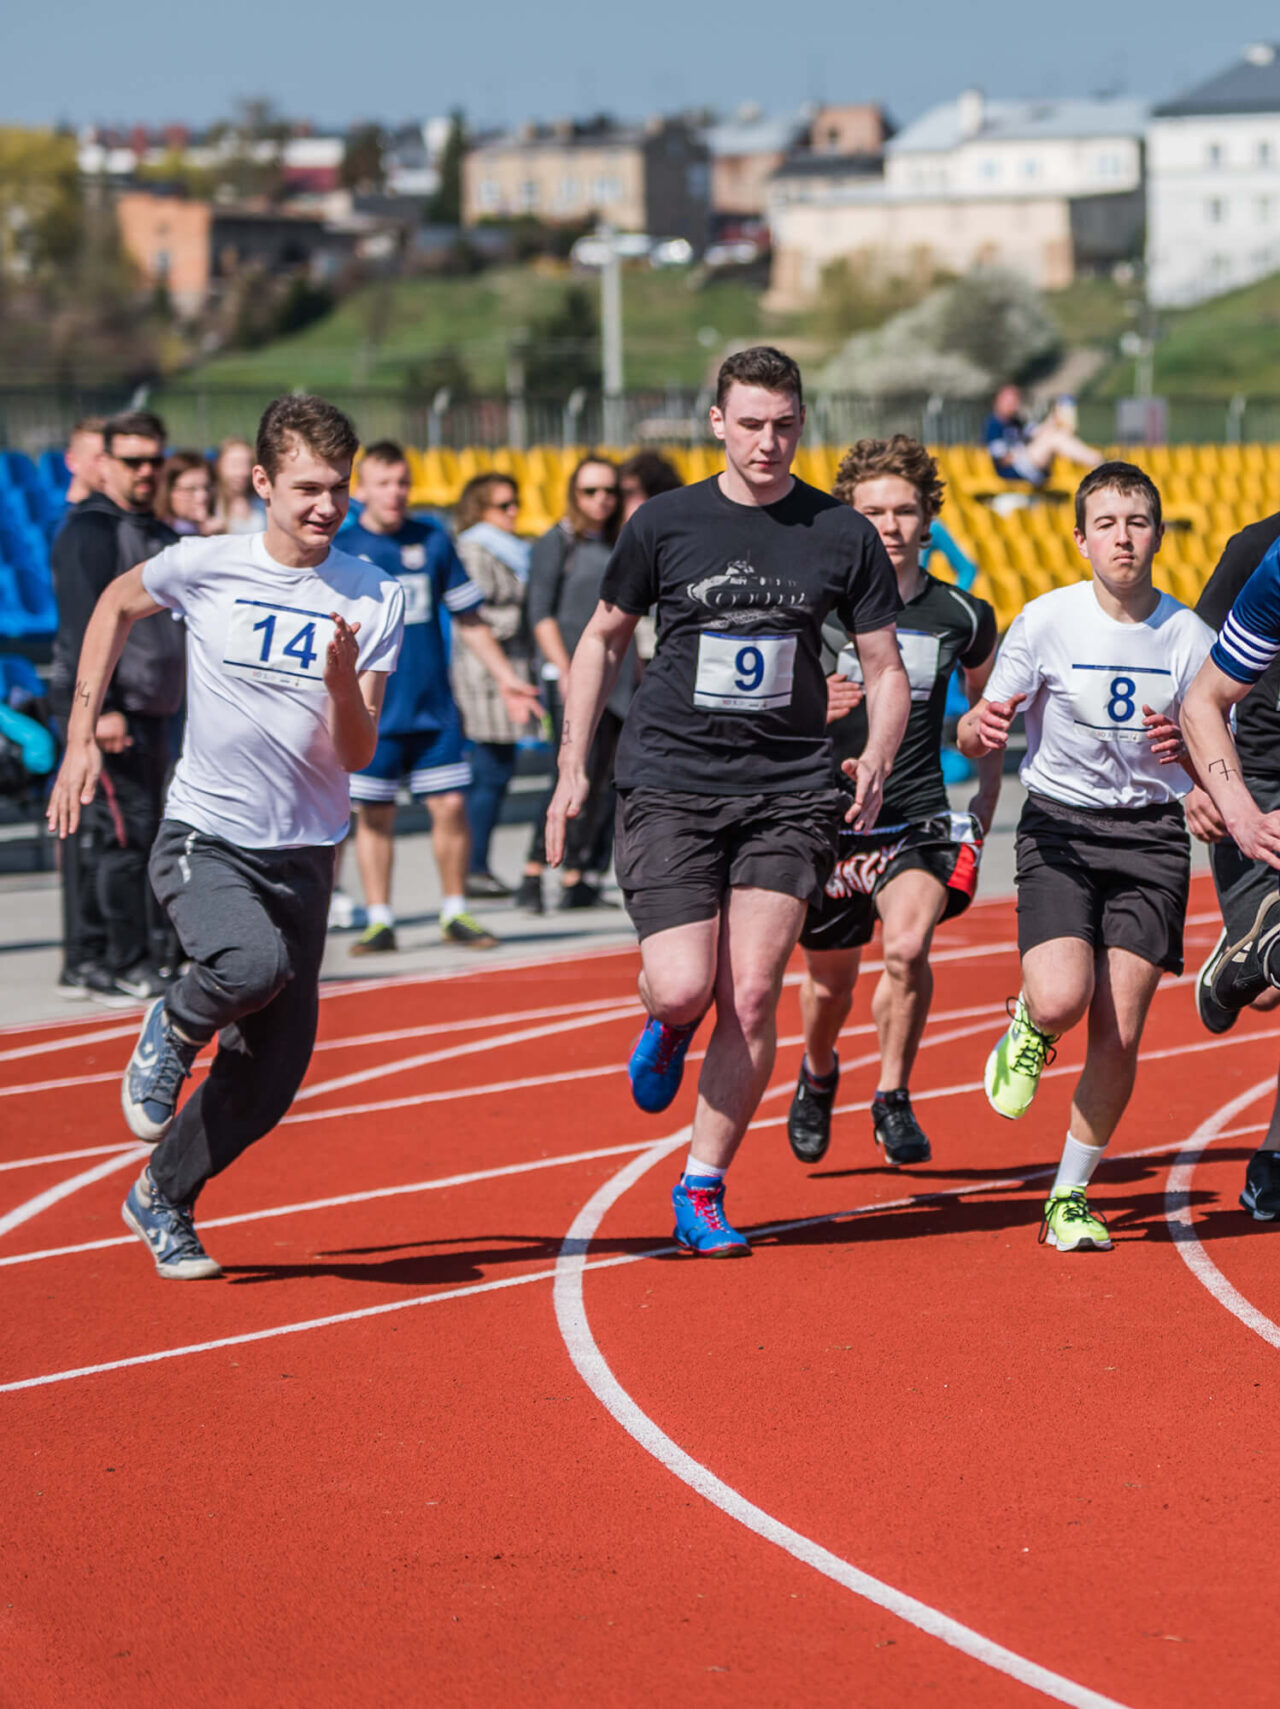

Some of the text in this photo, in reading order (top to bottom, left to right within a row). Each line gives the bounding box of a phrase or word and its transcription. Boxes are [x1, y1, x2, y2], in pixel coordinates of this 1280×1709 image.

[252, 614, 317, 669] 14
[734, 646, 765, 692] 9
[1107, 676, 1136, 722] 8
[1208, 758, 1237, 782] 7
